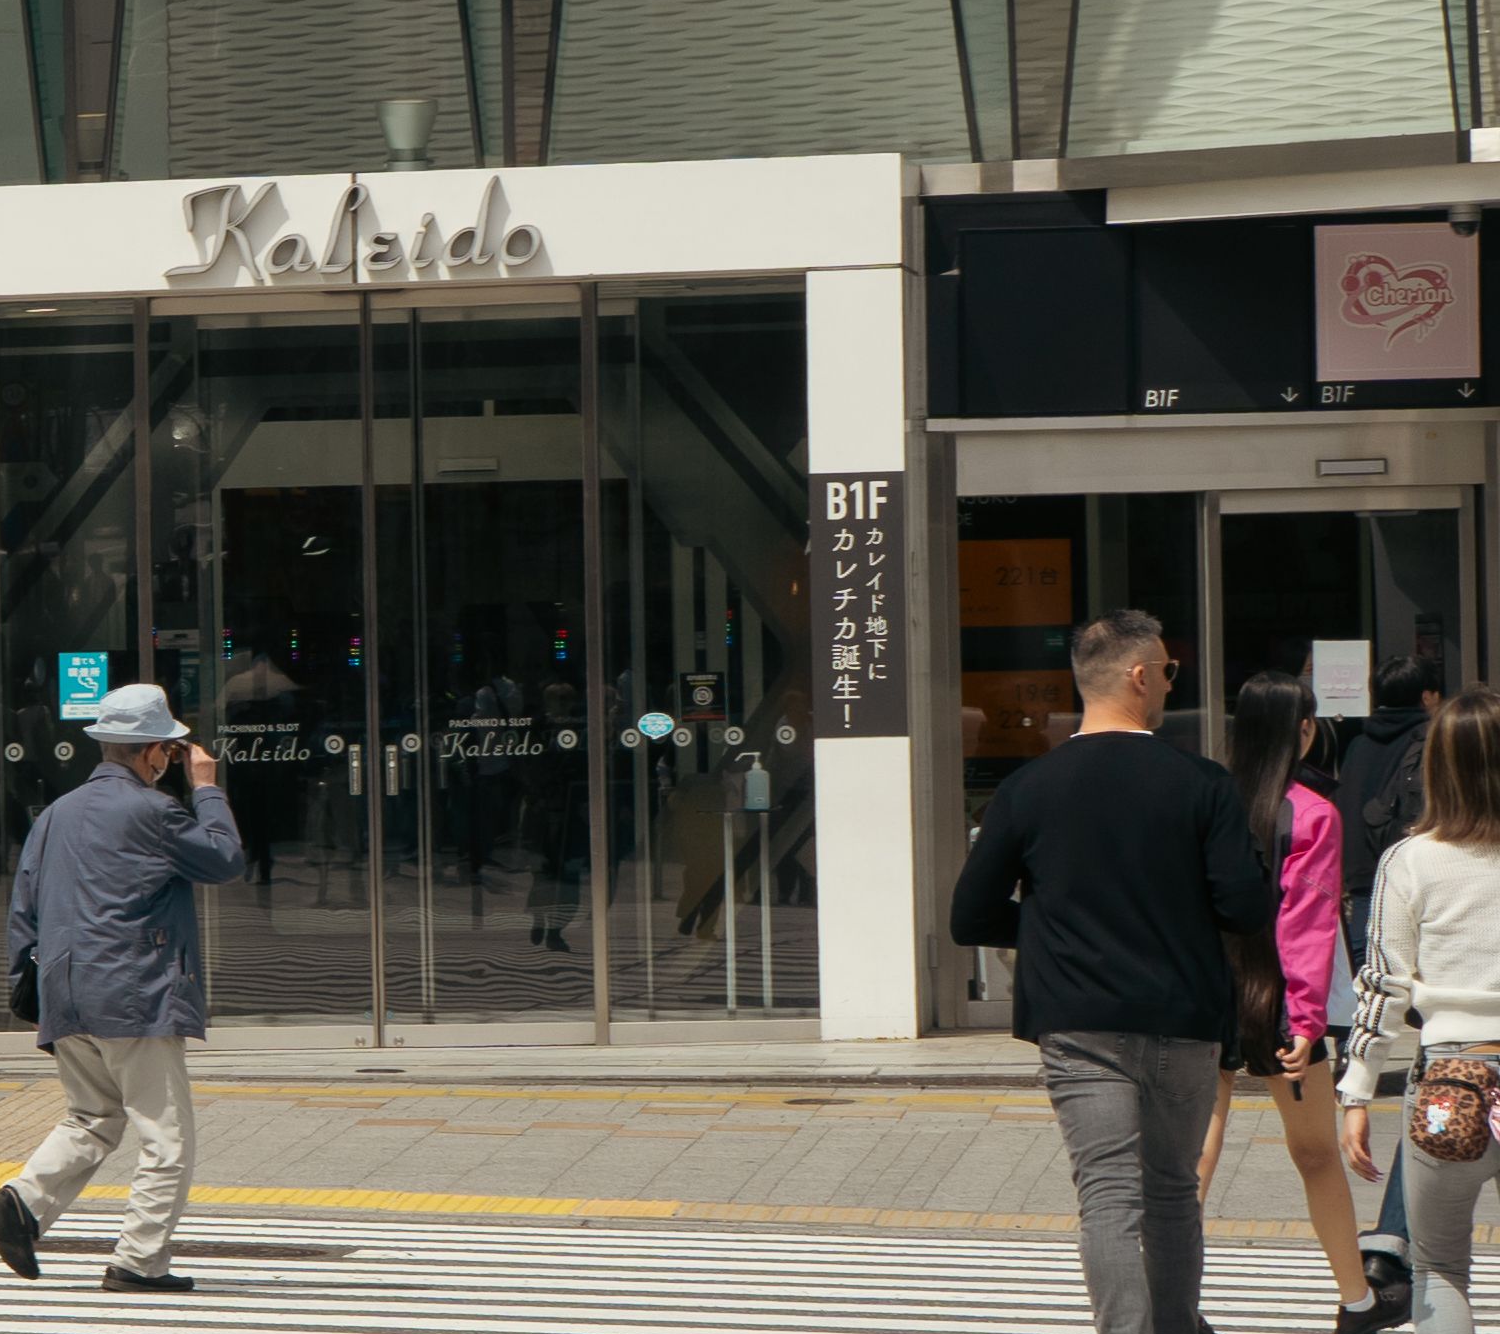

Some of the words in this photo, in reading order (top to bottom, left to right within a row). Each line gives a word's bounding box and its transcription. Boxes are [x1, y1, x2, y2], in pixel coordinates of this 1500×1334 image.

[164, 174, 545, 283] Kaleido
[1366, 279, 1454, 309] Cherian
[1145, 388, 1179, 409] B1F
[1321, 384, 1357, 405] B1F
[825, 482, 888, 522] B1F
[995, 566, 1059, 587] 221台
[865, 526, 889, 682] カレイド地下に
[218, 724, 265, 734] PACHINKO
[274, 723, 300, 733] SLOT
[448, 719, 498, 729] PACHINKO
[507, 717, 533, 727] SLOT
[212, 734, 311, 765] Kaleido
[439, 728, 544, 759] Kaleido
